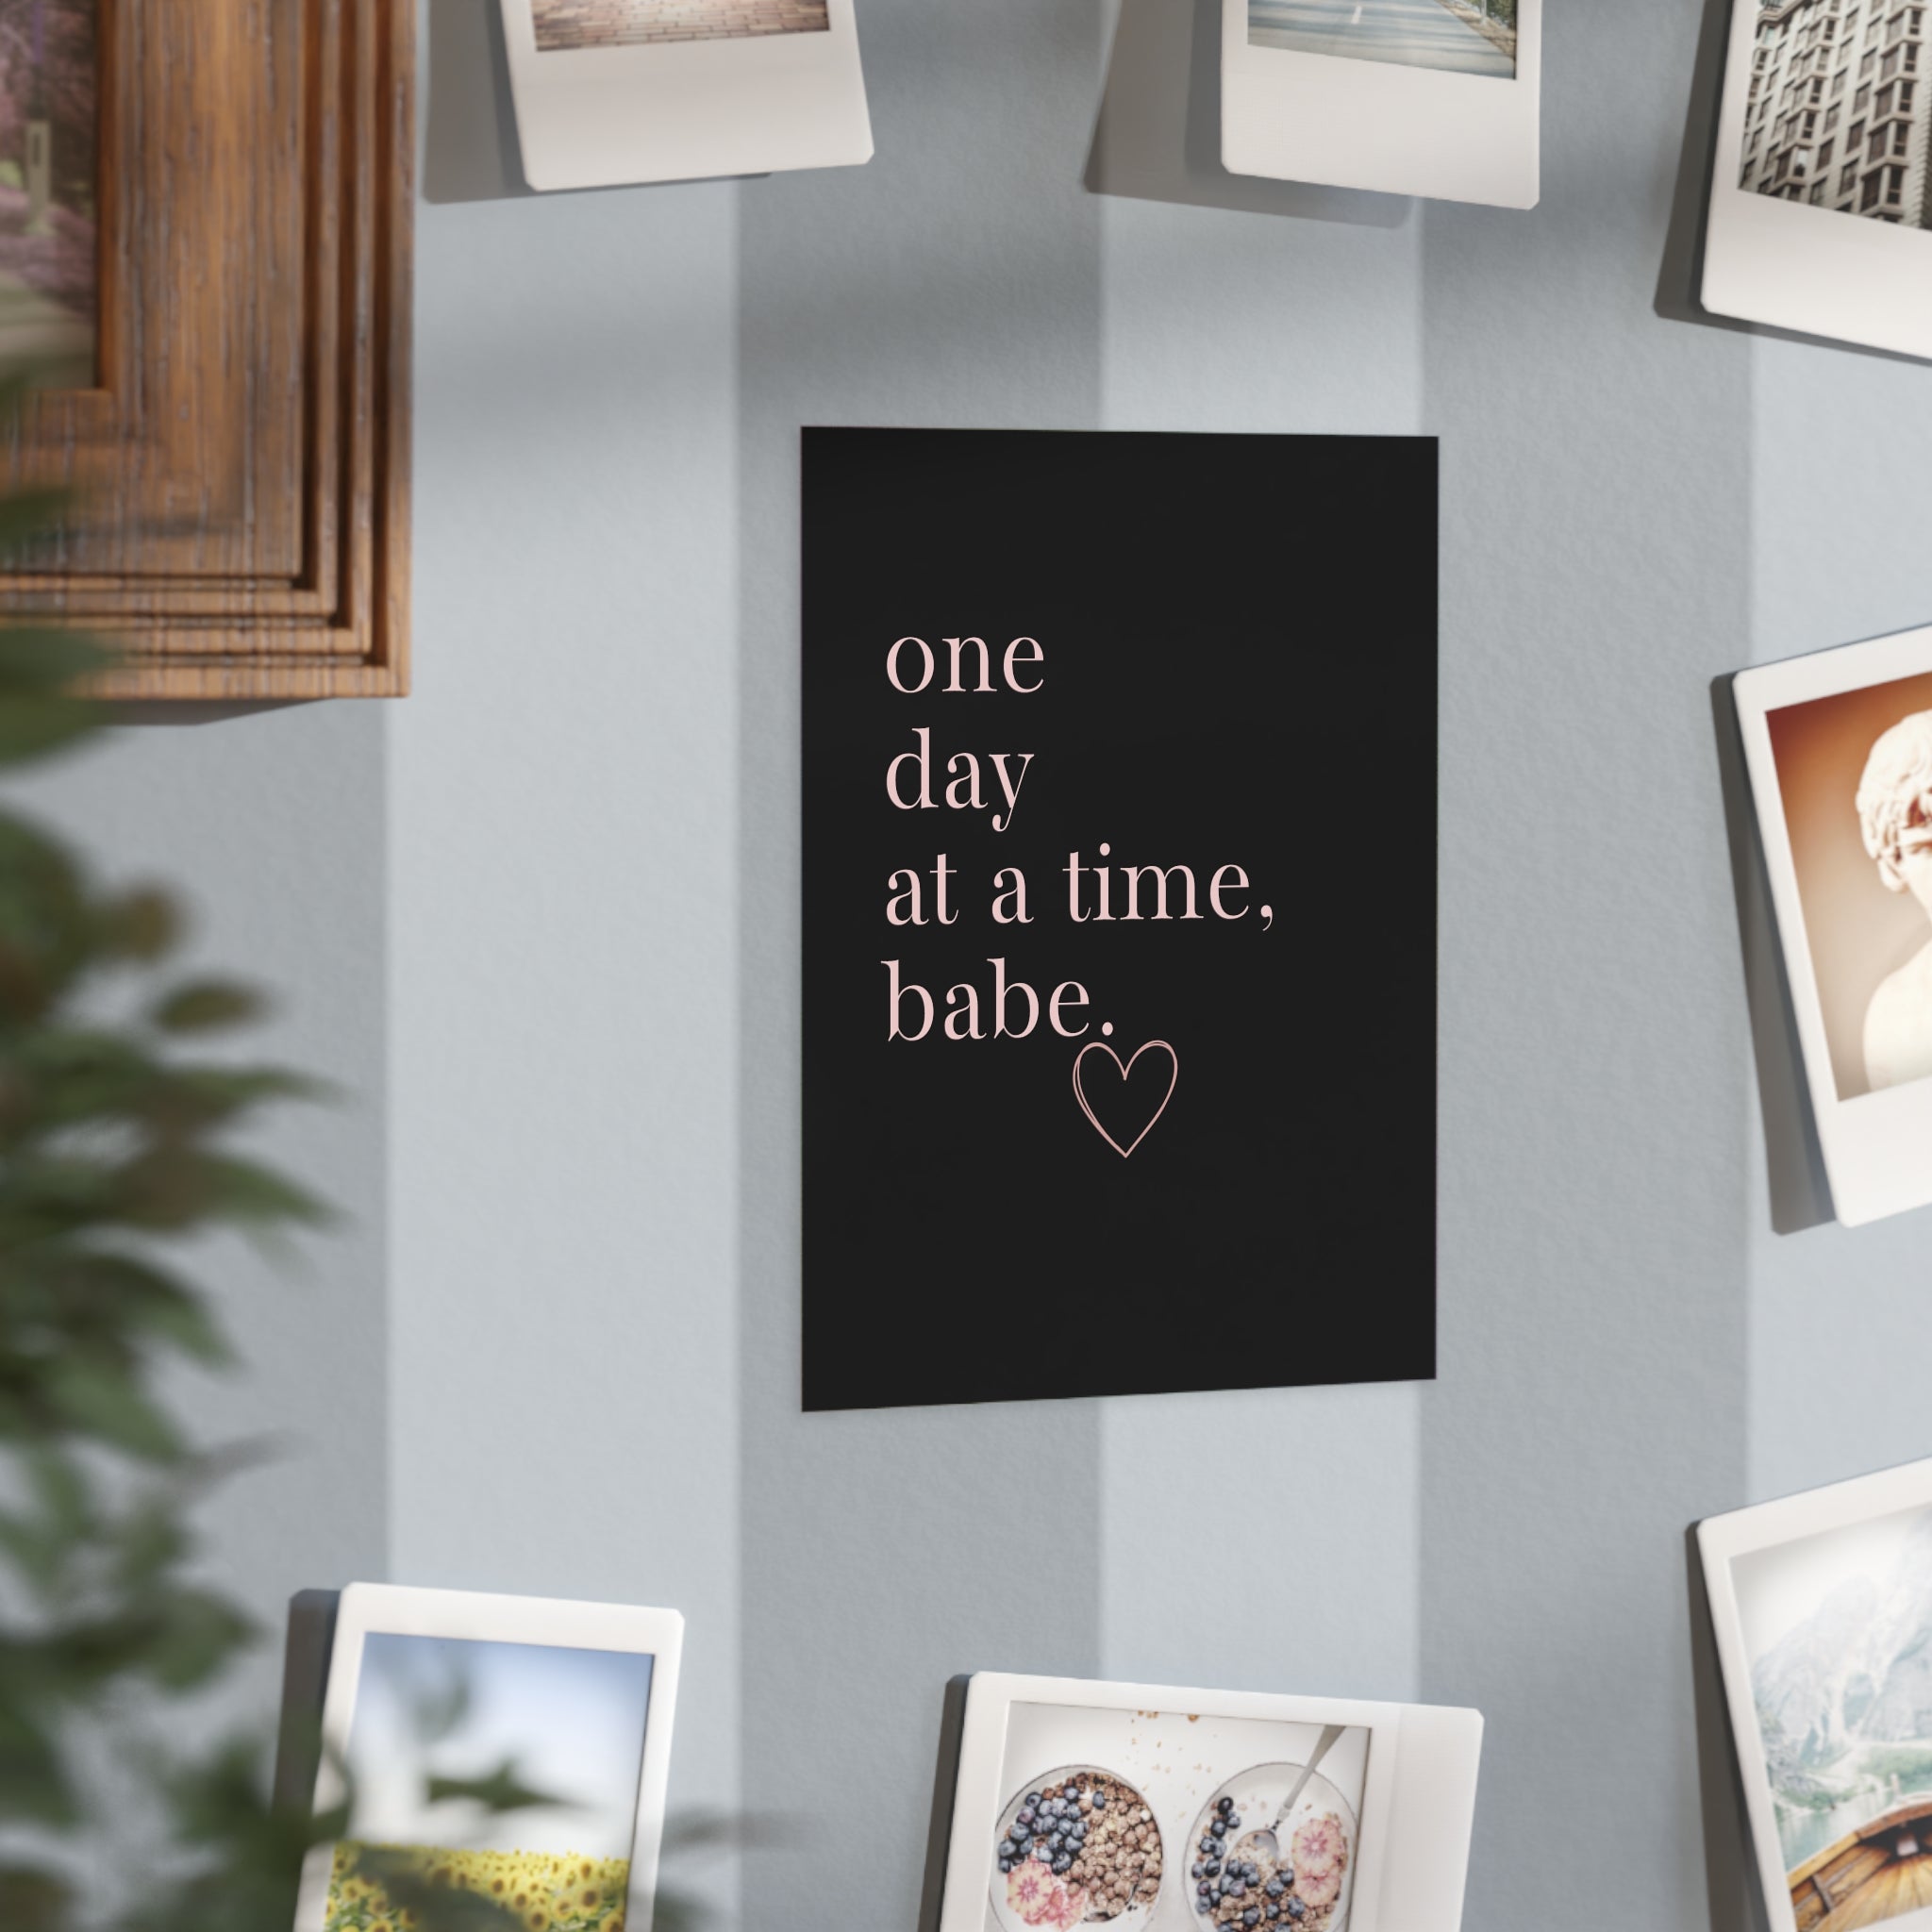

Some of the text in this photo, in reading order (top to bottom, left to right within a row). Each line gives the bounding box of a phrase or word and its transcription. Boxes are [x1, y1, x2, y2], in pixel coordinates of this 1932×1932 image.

[886, 636, 1044, 693] one
[886, 726, 1035, 832] day
[886, 842, 1274, 932] at a time,
[880, 957, 1114, 1042] babe.
